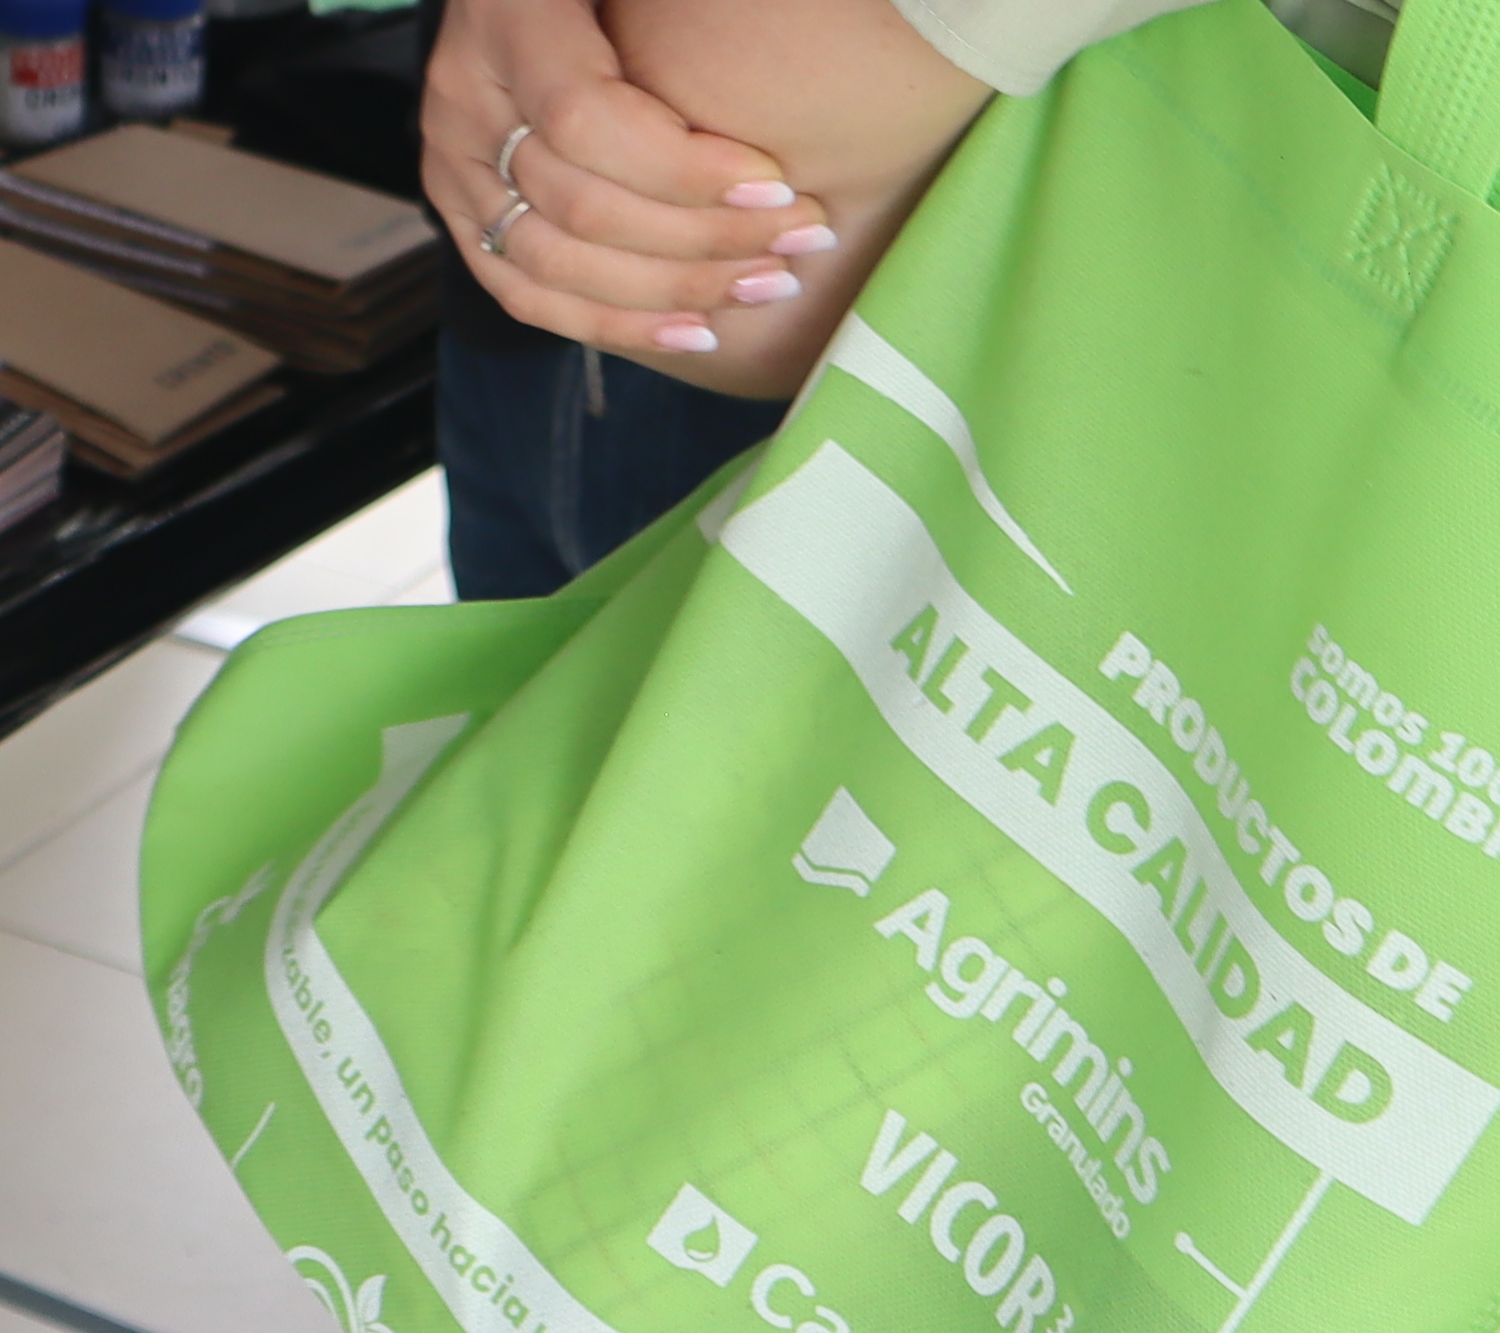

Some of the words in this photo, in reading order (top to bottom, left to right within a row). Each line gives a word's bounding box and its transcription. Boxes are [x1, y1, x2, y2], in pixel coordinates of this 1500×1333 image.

[1097, 630, 1376, 956] PRODUCTOS
[1368, 928, 1475, 1024] DE
[1307, 622, 1425, 746] somos
[889, 602, 1077, 807] ALTA
[1084, 778, 1395, 1125] CALIDAD
[337, 1057, 375, 1114] un
[364, 1115, 429, 1217] paso
[431, 1213, 531, 1328] hacia
[873, 885, 1172, 1206] Agrimins
[1020, 1081, 1132, 1239] Granulado
